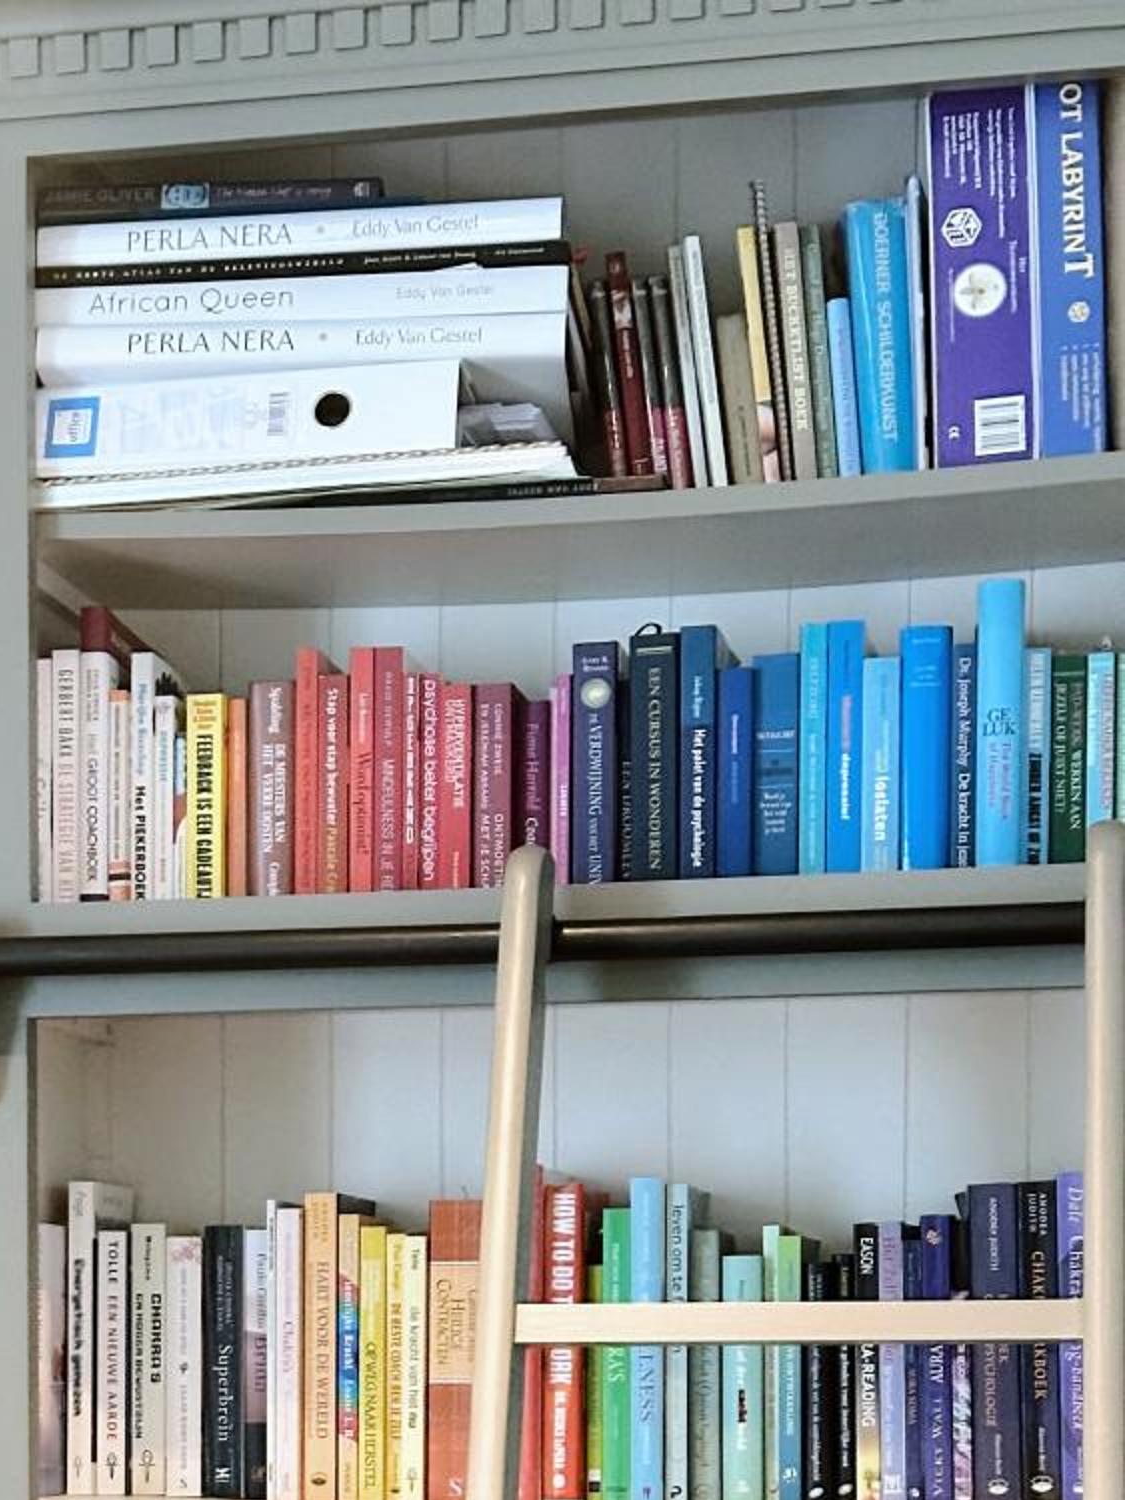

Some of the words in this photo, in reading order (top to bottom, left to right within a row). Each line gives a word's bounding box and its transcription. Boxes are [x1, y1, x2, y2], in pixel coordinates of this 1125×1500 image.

[1060, 132, 1094, 278] LABYRINT
[128, 227, 208, 252] PERLA
[220, 223, 292, 247] NERA
[353, 219, 391, 237] Eddy
[394, 217, 422, 234] Van
[426, 214, 479, 231] Gestel
[89, 292, 188, 314] African
[201, 287, 294, 313] Queen
[128, 332, 210, 353] PERLA
[222, 330, 294, 351] NERA
[356, 330, 391, 347] Eddy
[398, 329, 425, 344] Van
[430, 327, 482, 343] Gestel
[877, 302, 898, 443] SCHILDERKUNST
[648, 667, 661, 695] EEN
[956, 679, 971, 717] Joseph
[326, 688, 339, 715] Stap
[420, 679, 437, 754] psychose
[327, 718, 337, 743] voor
[648, 699, 661, 758] CURSUS
[692, 729, 706, 747] Het
[956, 720, 971, 766] Murphy
[196, 734, 213, 794] FEEDBACK
[326, 745, 338, 770] stap
[587, 724, 602, 816] VERDWIJNING
[649, 762, 661, 779] IN
[1069, 750, 1082, 801] WERKEN
[134, 785, 147, 810] Het
[326, 772, 339, 825] bewuster
[381, 759, 394, 839] MINDFULNESS
[424, 760, 437, 803] beter
[693, 776, 704, 793] van
[958, 772, 971, 791] De
[197, 798, 213, 810] IS
[693, 796, 706, 807] de
[873, 775, 890, 841] loslaten
[958, 791, 971, 828] kracht
[1070, 804, 1082, 831] AAN
[86, 805, 99, 882] COACHBOEK
[197, 813, 213, 835] EEN
[421, 806, 437, 881] begrijpen
[481, 814, 490, 840] MET
[649, 782, 662, 871] WONDEREN
[135, 814, 147, 901] PIEKERBOEK
[552, 1192, 574, 1236] HOW
[672, 1204, 683, 1253] leven
[1027, 1194, 1037, 1234] JUDITH
[107, 1241, 119, 1284] TOLLE
[554, 1239, 575, 1260] TO
[673, 1256, 683, 1272] om
[860, 1236, 874, 1275] EASON
[316, 1261, 329, 1303] HART
[555, 1266, 575, 1291] DO
[673, 1276, 683, 1293] te
[72, 1258, 85, 1350] Energetisch
[107, 1295, 118, 1324] EEN
[408, 1306, 420, 1322] de
[316, 1307, 330, 1349] VOOR
[408, 1325, 420, 1361] kracht
[107, 1327, 118, 1386] NIEUWE
[316, 1354, 329, 1378] DE
[409, 1365, 418, 1386] van
[71, 1354, 82, 1416] genezen
[213, 1344, 232, 1442] Superbrein
[409, 1389, 420, 1408] het
[107, 1391, 118, 1441] AARDE
[316, 1384, 329, 1439] WERELD
[363, 1432, 376, 1489] HERSTEL
